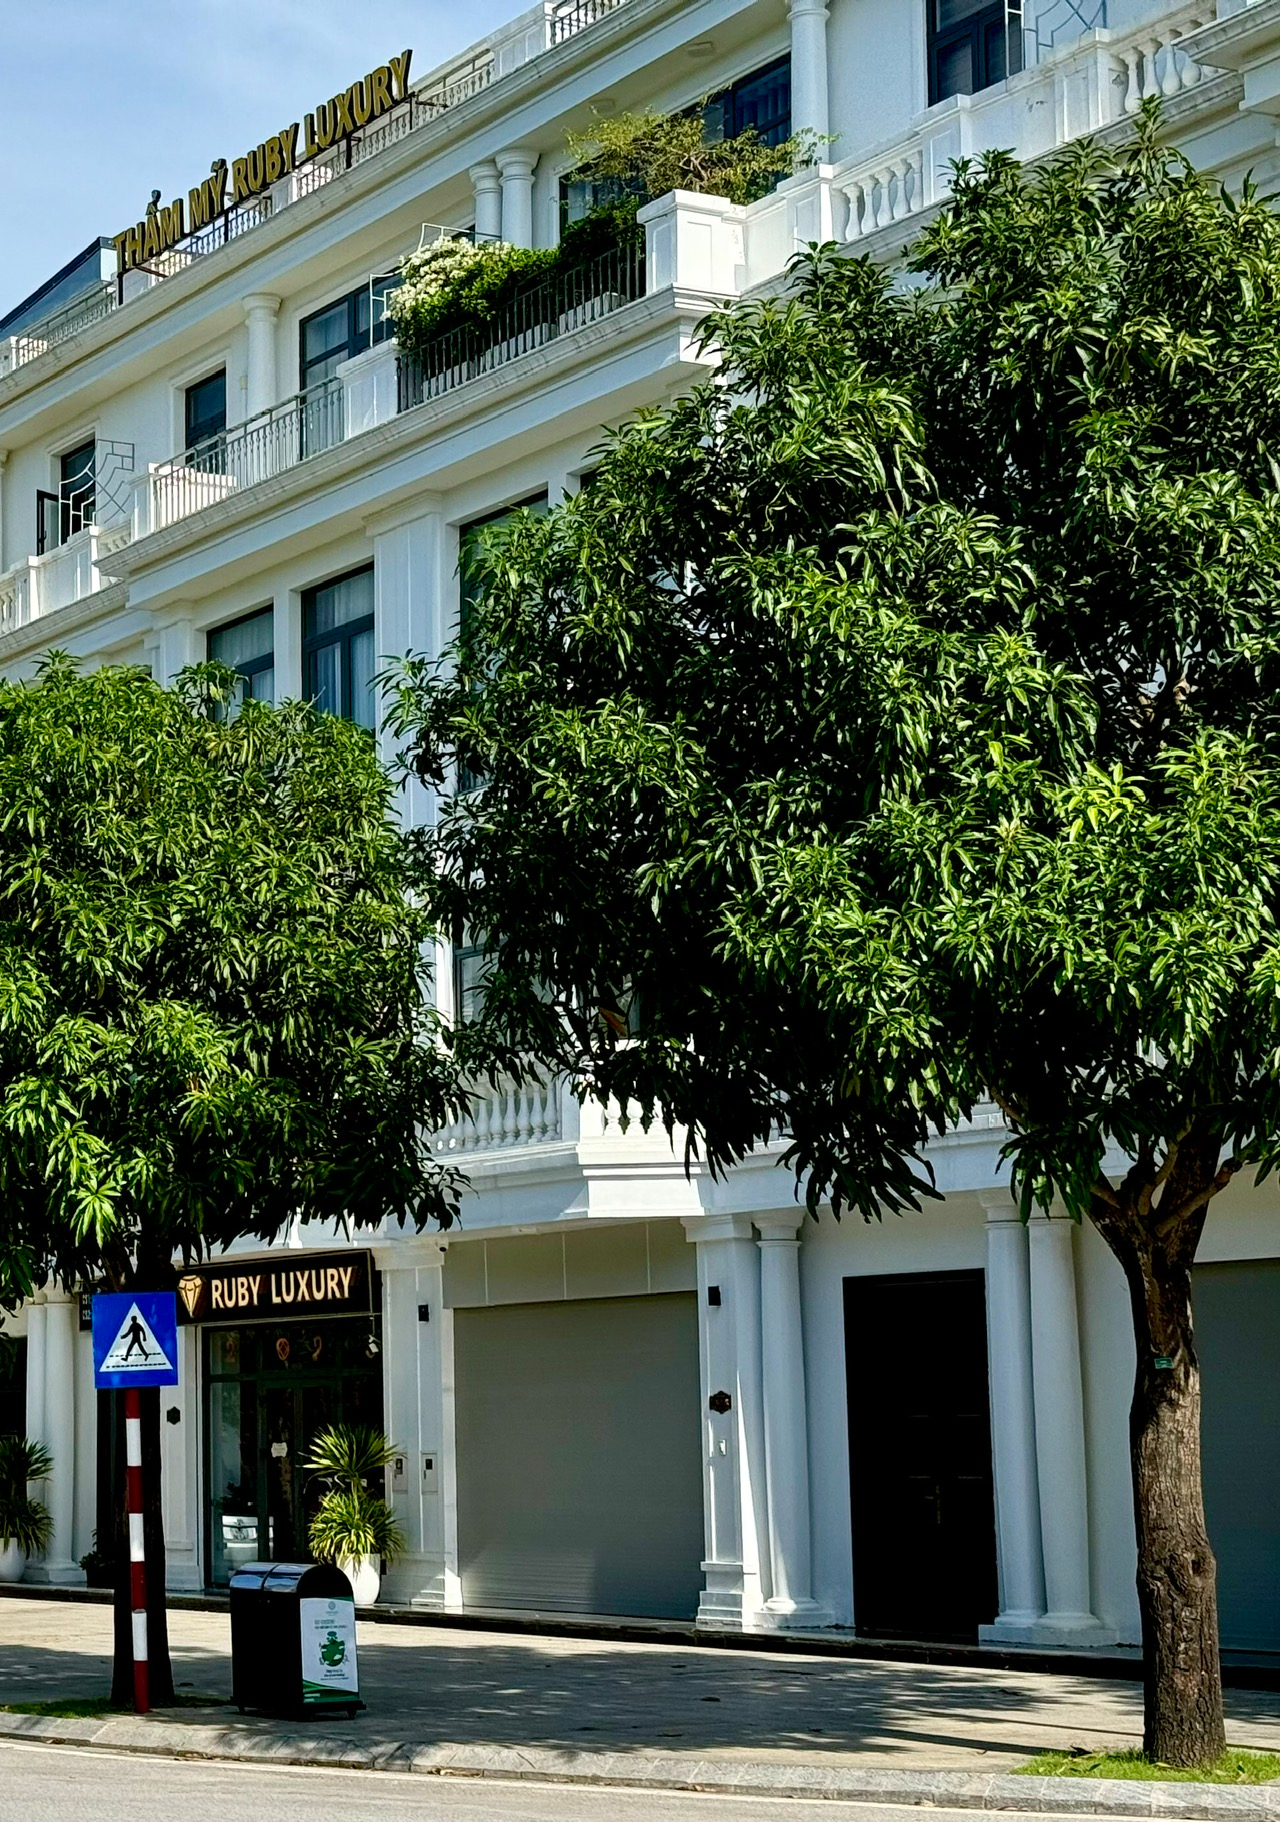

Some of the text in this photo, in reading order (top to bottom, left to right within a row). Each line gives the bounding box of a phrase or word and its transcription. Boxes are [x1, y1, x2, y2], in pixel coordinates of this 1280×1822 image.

[112, 49, 413, 272] THẨM MỸ RUBY LUXURY
[211, 1266, 353, 1309] RUBY LUXURY
